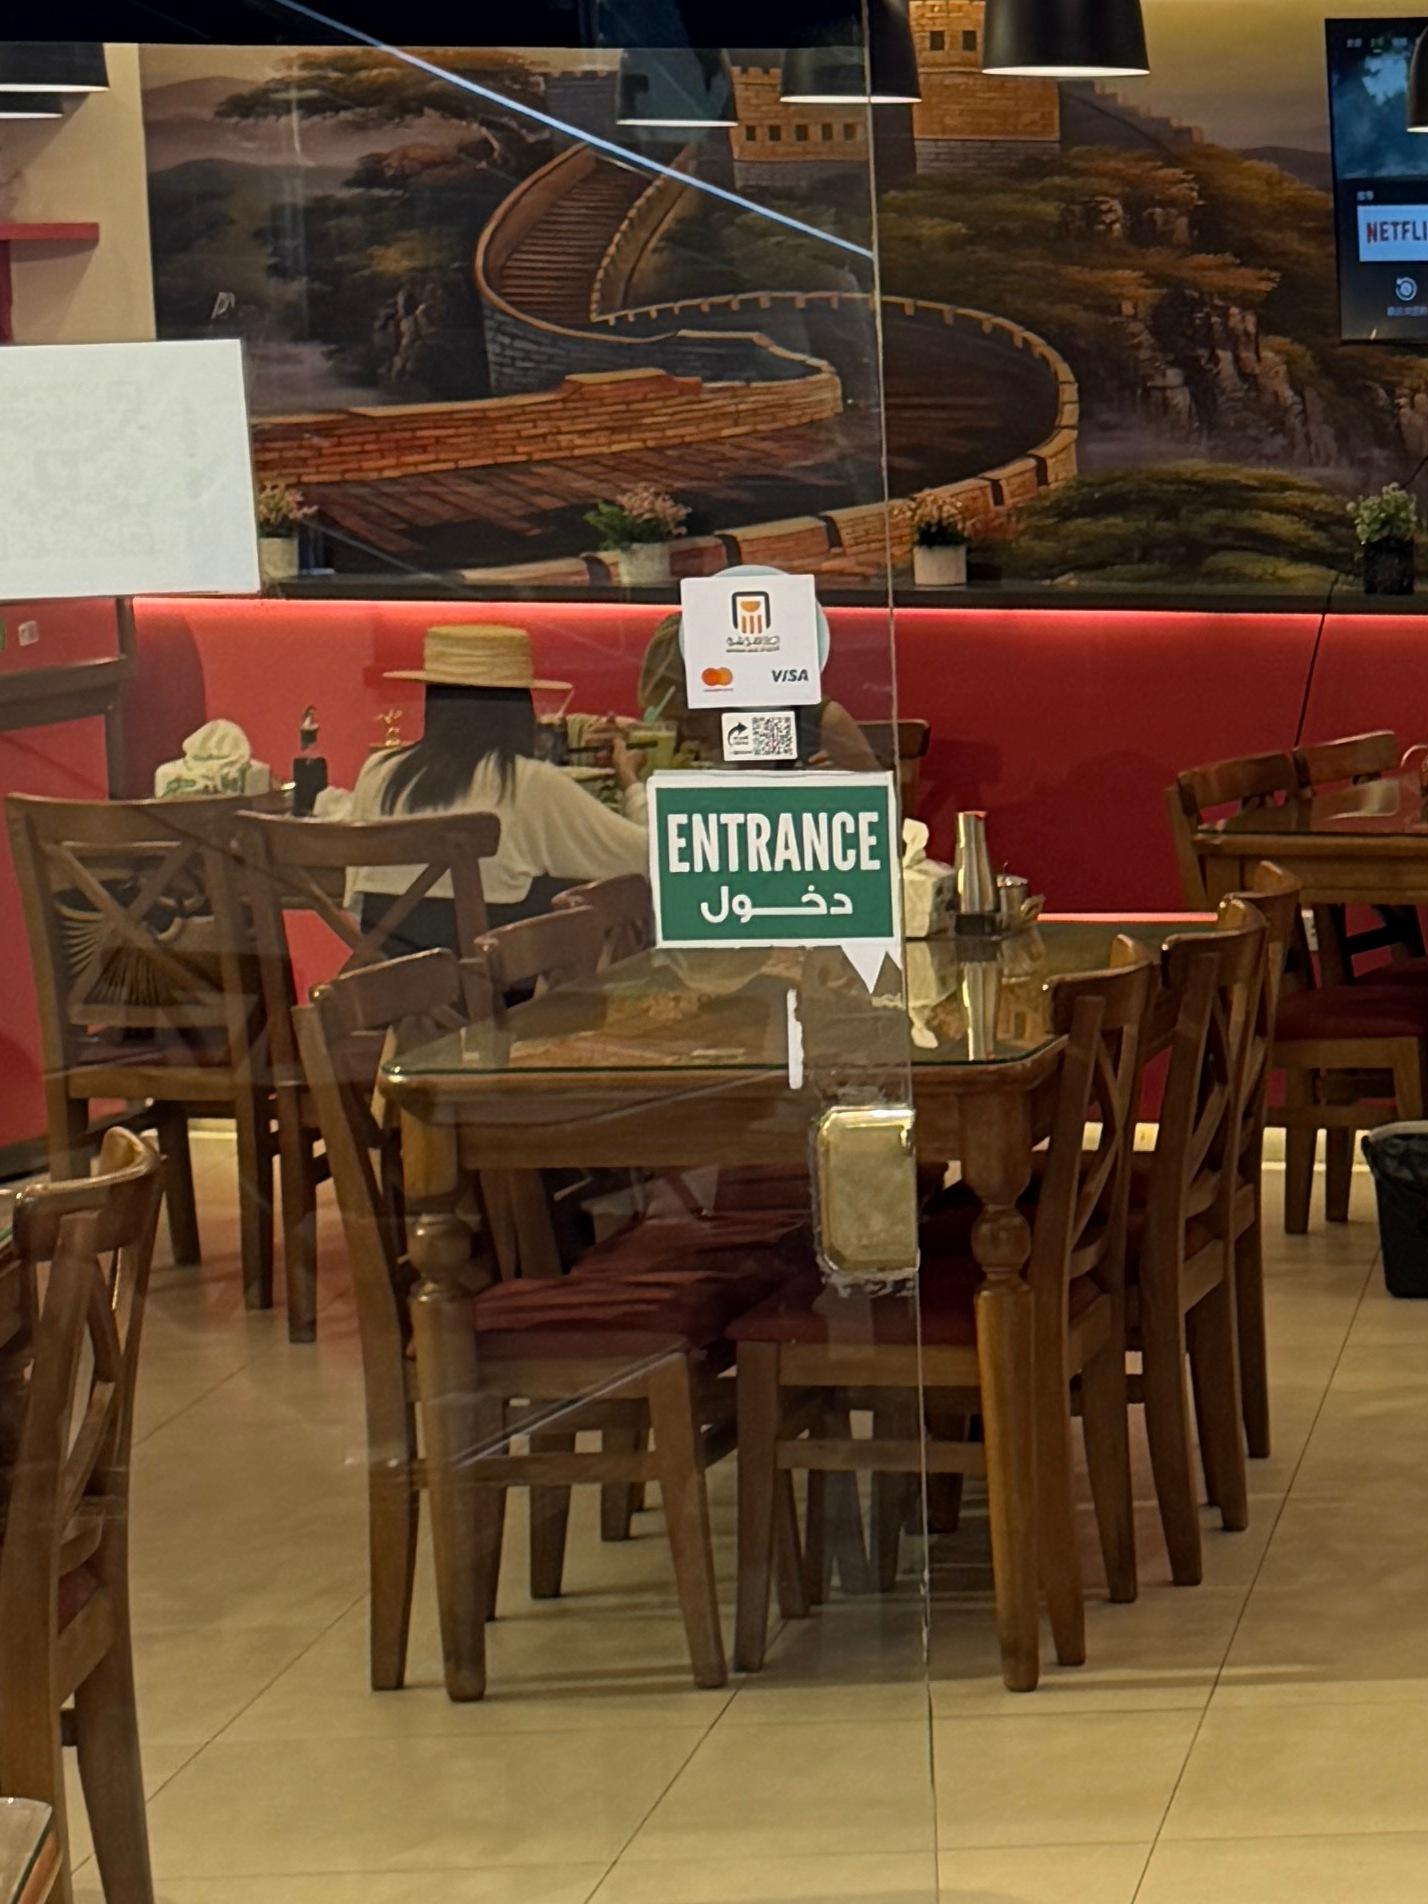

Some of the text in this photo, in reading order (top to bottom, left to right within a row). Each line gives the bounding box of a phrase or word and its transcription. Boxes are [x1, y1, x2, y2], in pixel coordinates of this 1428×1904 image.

[771, 669, 809, 683] VISA
[667, 811, 881, 873] ENTRANCE
[700, 884, 854, 924] دخول
